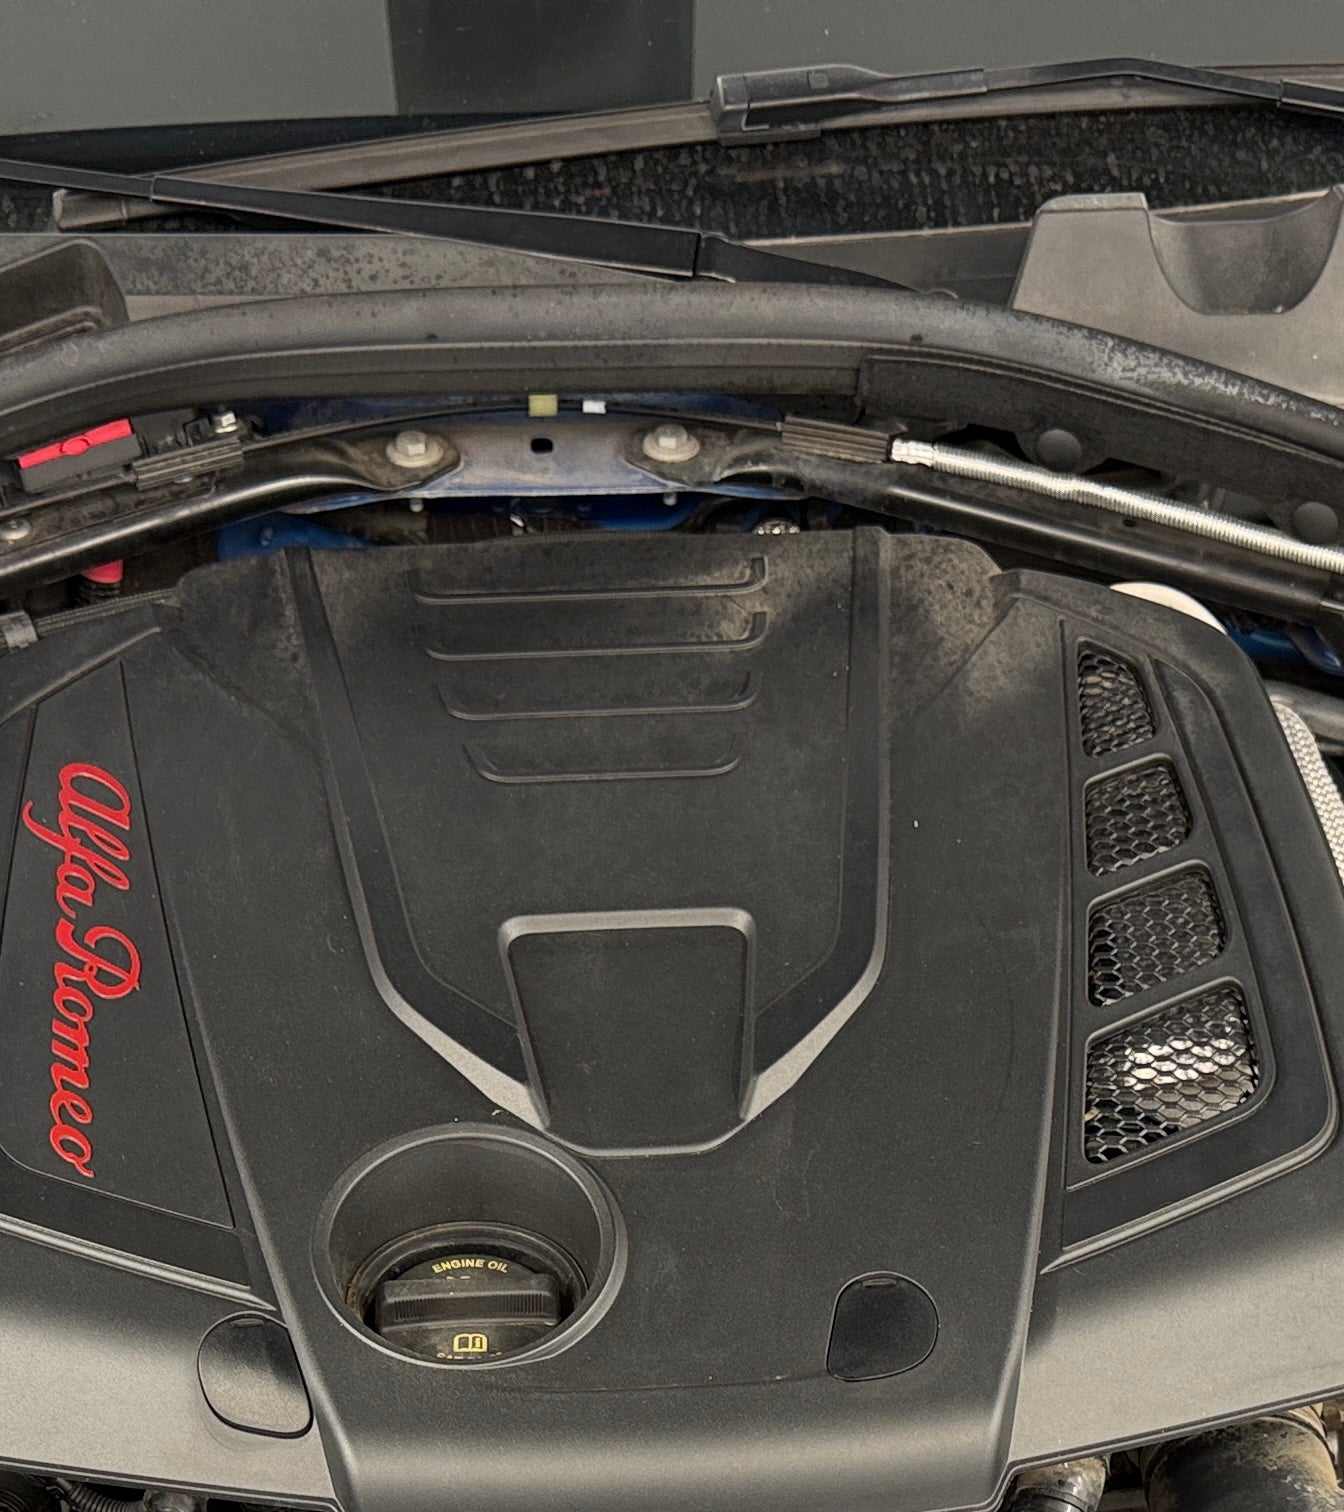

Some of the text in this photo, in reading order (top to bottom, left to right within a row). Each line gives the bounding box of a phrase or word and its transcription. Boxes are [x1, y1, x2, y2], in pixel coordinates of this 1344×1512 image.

[22, 762, 140, 1178] Alfa Romeo
[431, 1258, 509, 1274] ENGINE OIL
